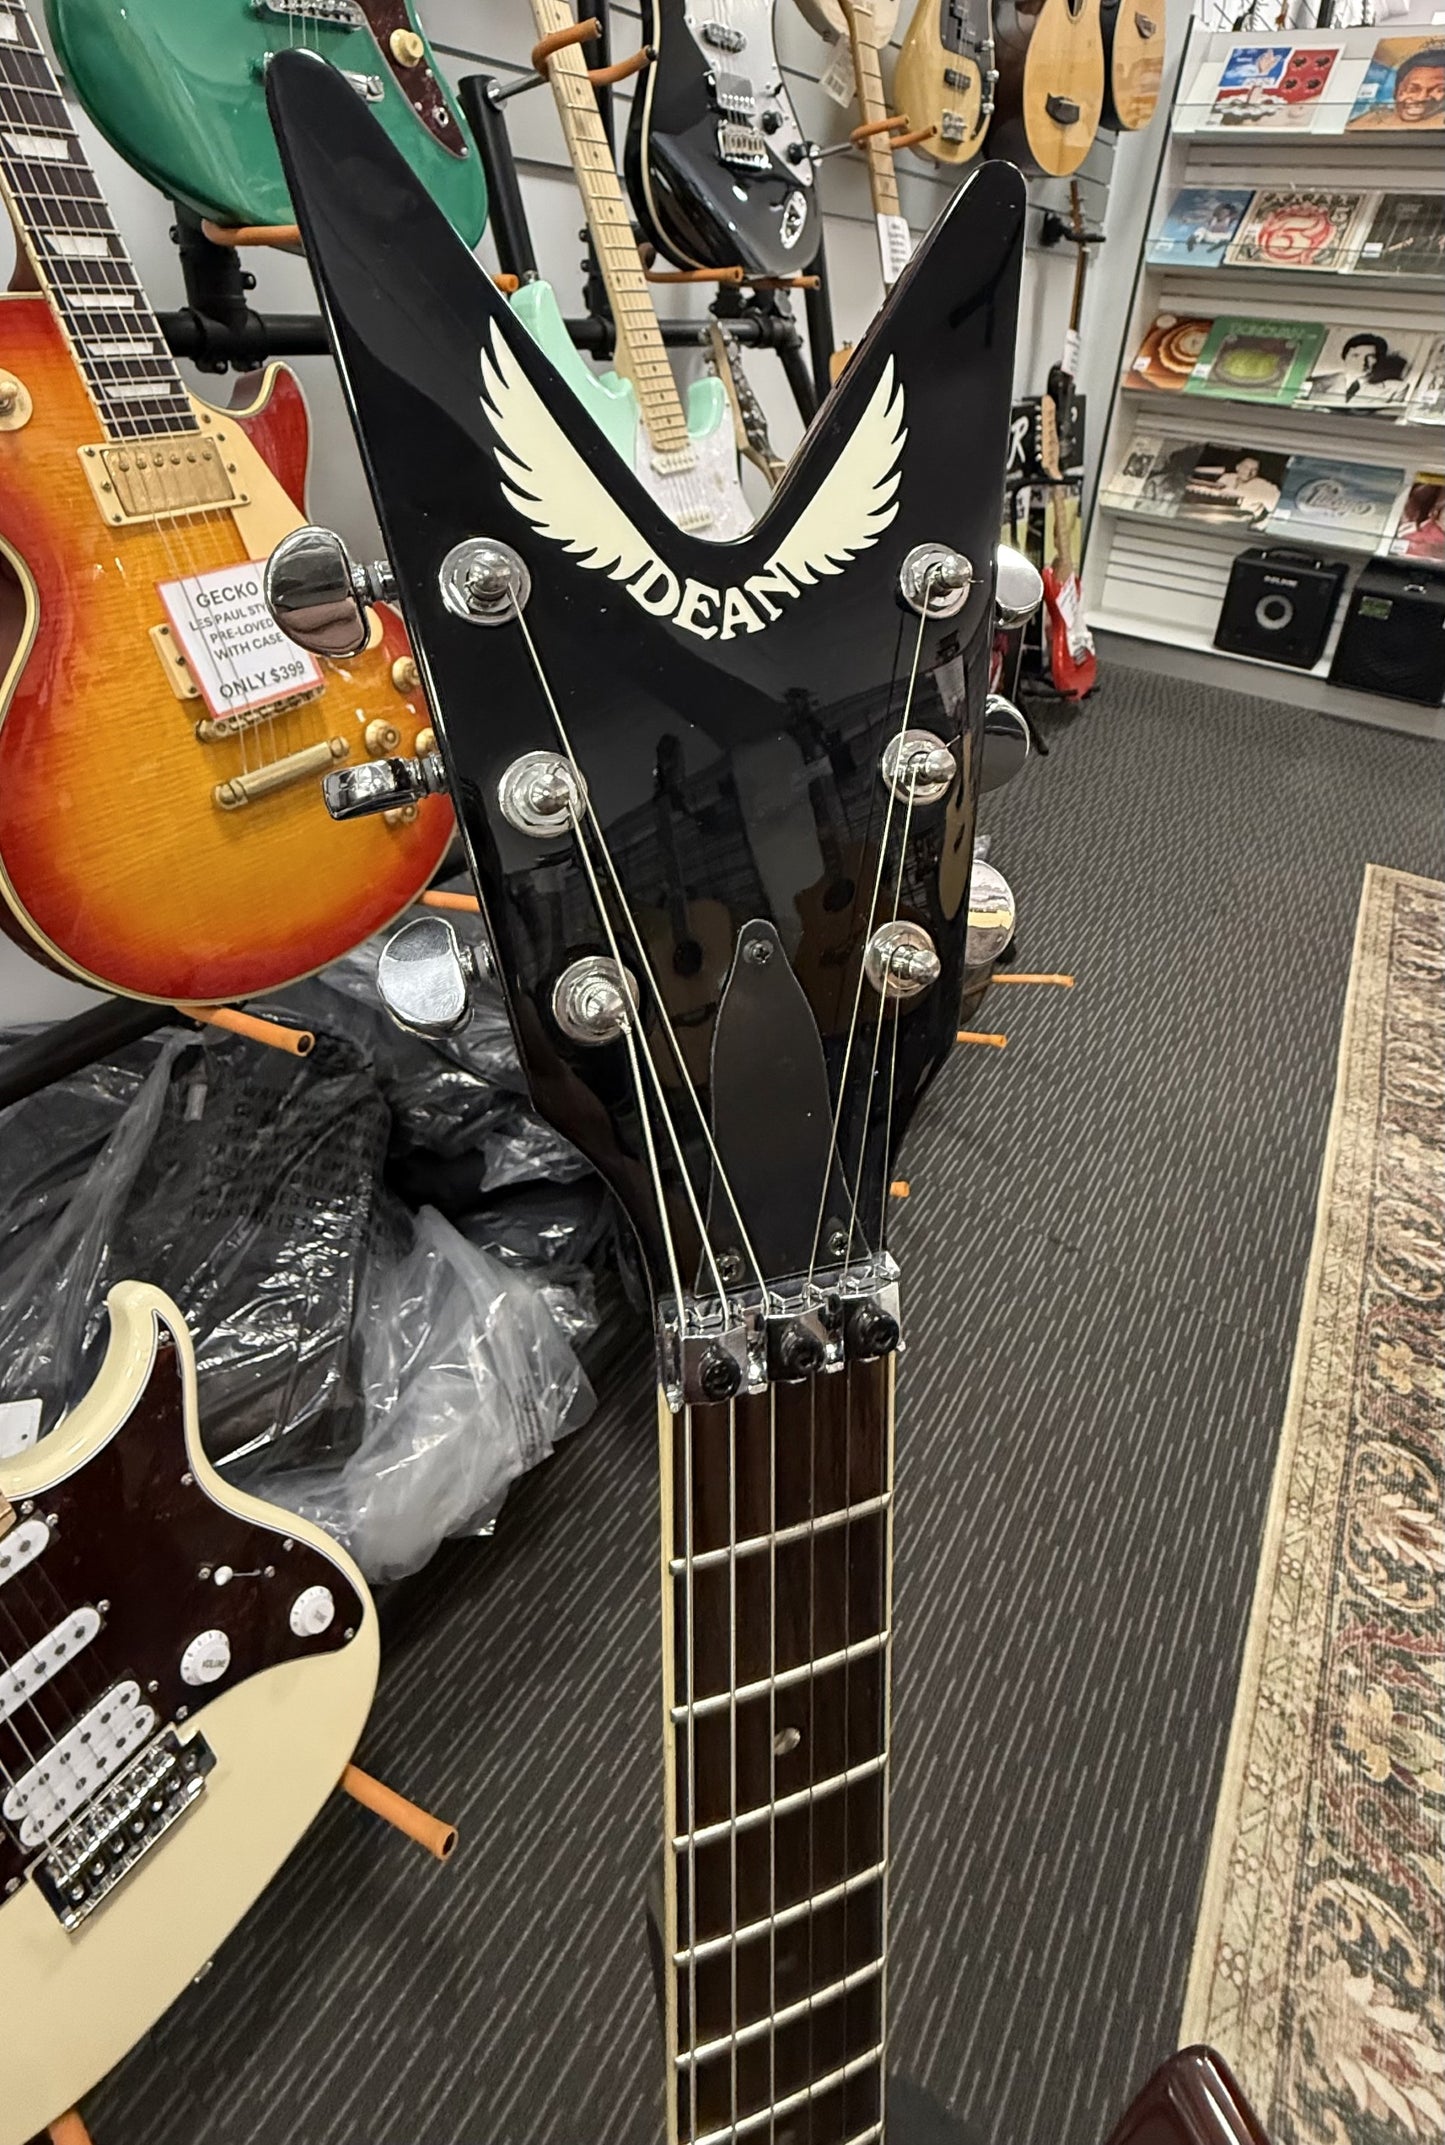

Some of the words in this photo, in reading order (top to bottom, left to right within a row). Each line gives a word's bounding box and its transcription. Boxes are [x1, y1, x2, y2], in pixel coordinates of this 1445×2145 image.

[196, 580, 259, 609] GECKO
[626, 557, 802, 641] DEAN
[188, 615, 213, 632] LES
[214, 608, 247, 625] PAUL
[249, 602, 267, 616] STY
[209, 617, 274, 644] PRE-LOVED
[213, 642, 252, 661] WITH
[252, 634, 283, 651] CASE
[219, 671, 271, 700] ONLY
[270, 660, 306, 684] $399
